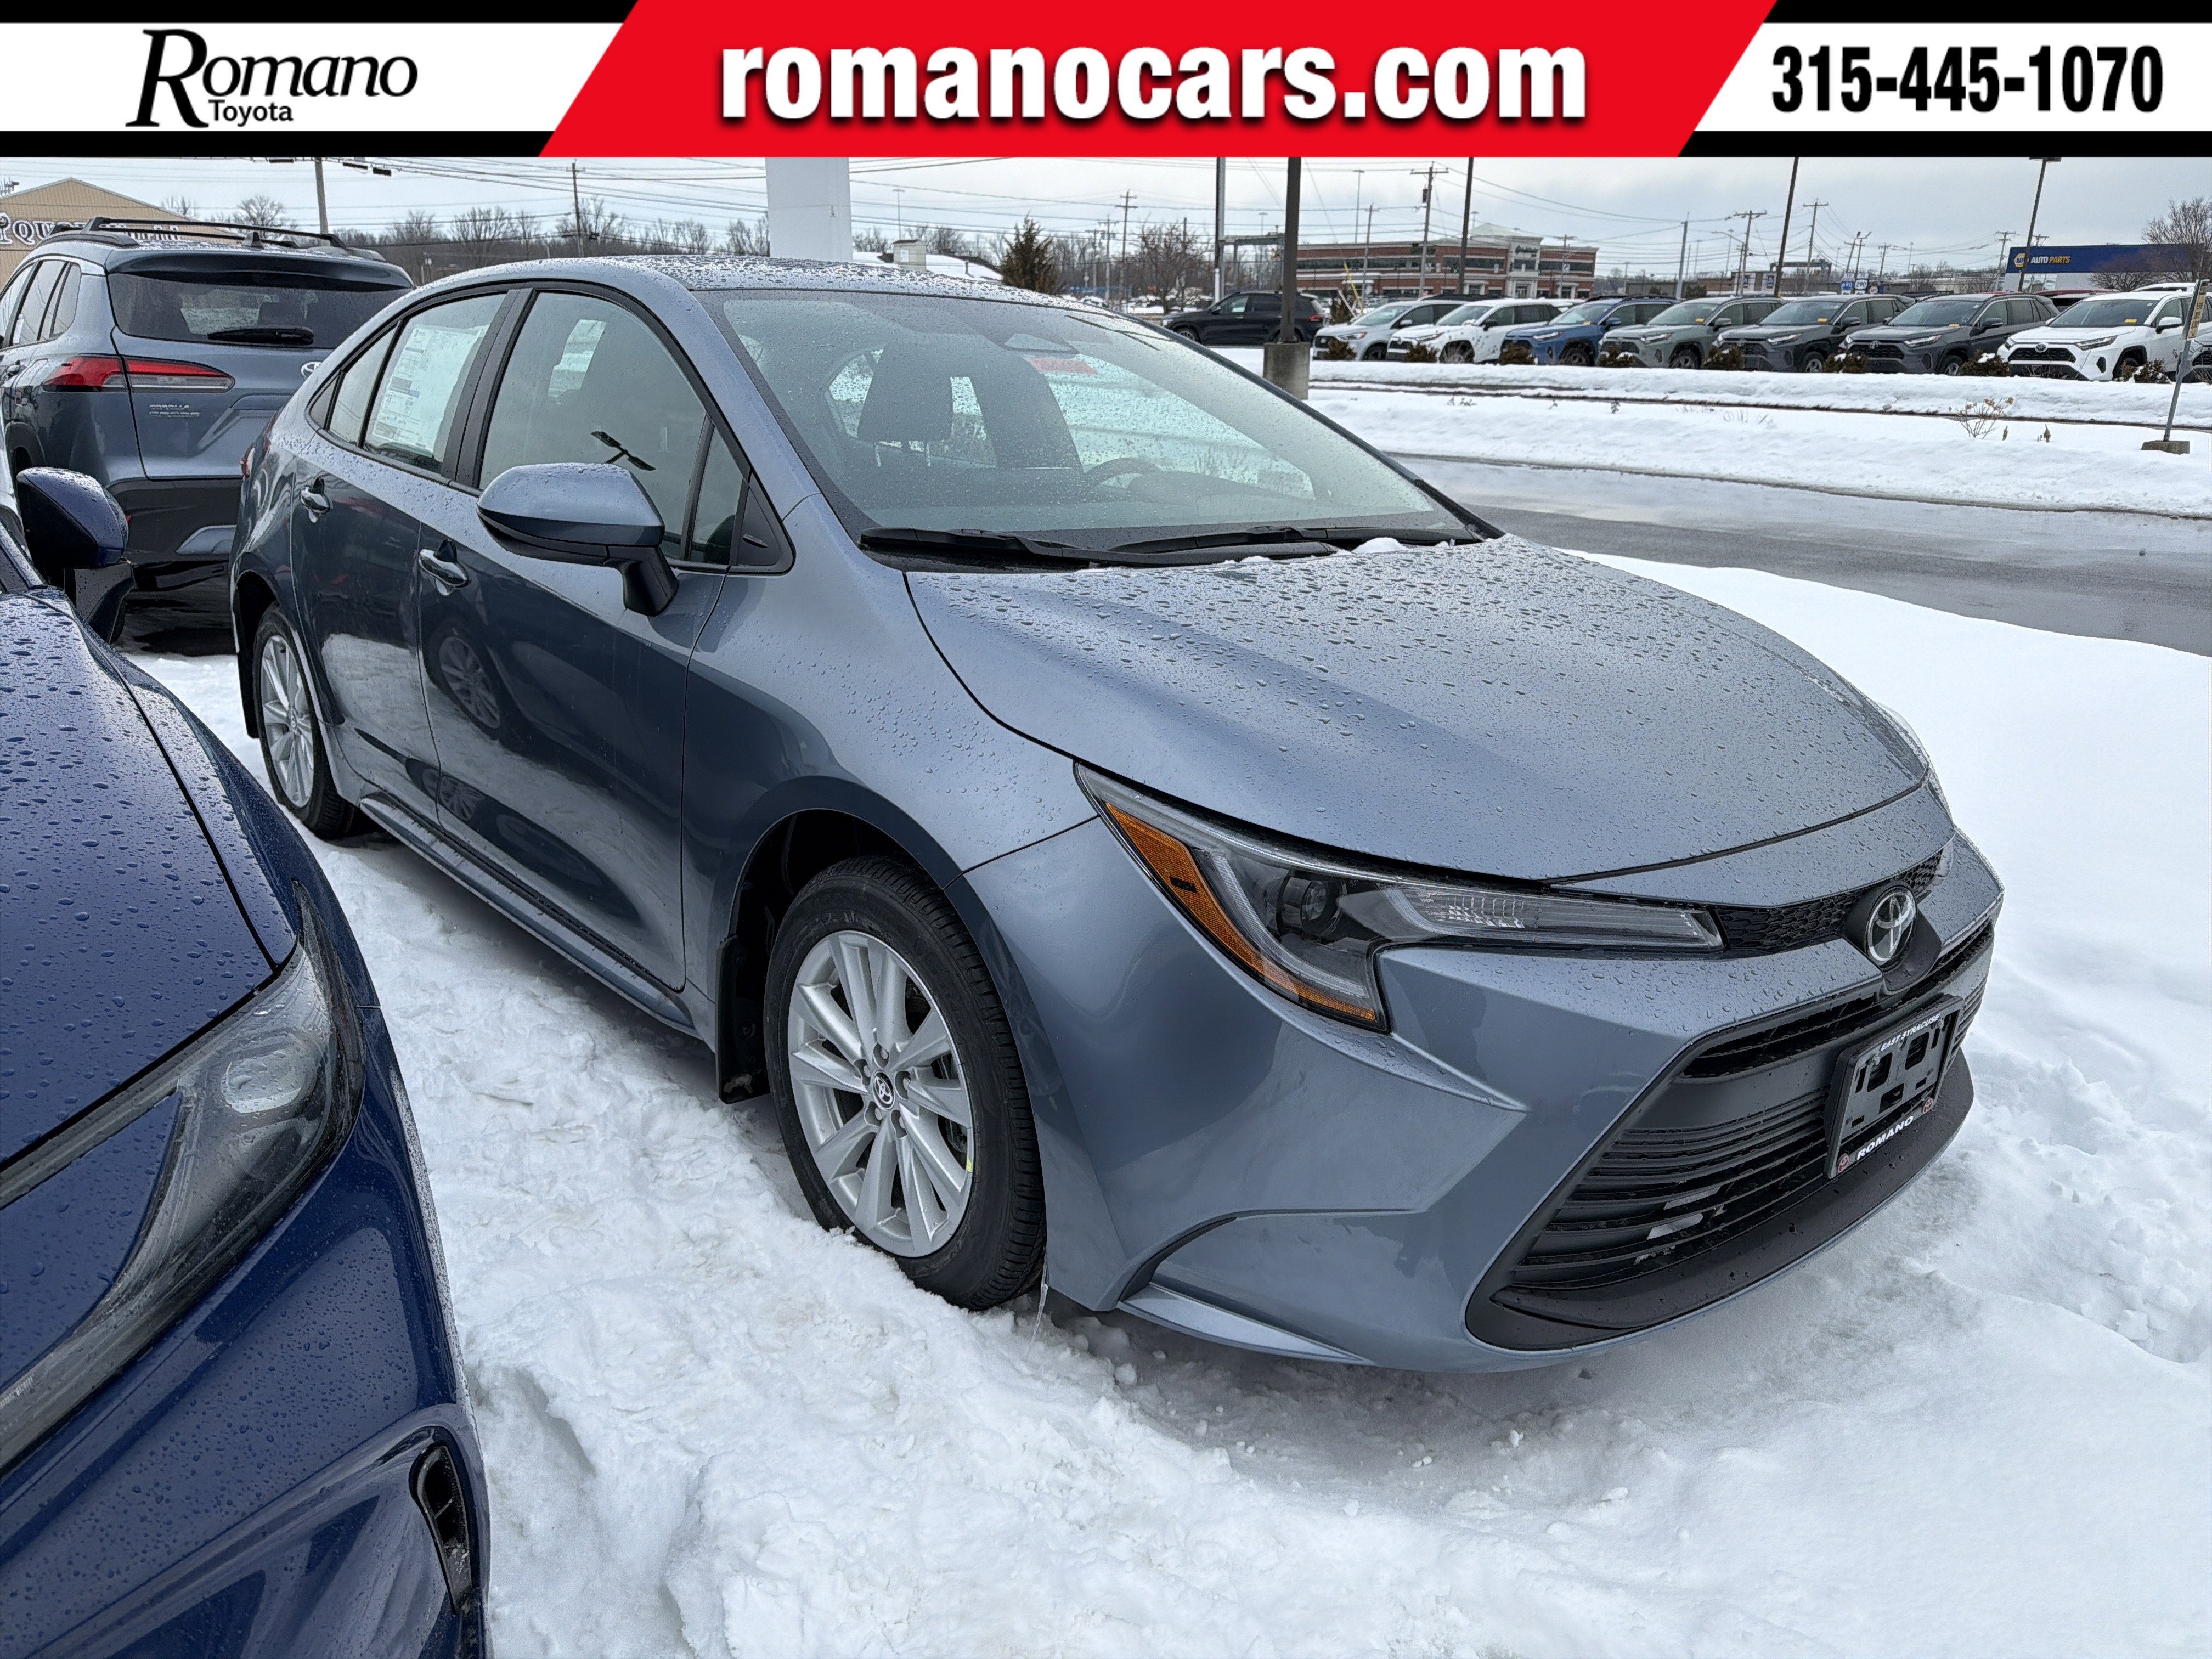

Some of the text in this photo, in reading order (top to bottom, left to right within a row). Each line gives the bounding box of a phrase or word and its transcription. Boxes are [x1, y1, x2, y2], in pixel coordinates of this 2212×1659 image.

[2030, 256, 2049, 264] AUTO
[1880, 1013, 1941, 1052] EAST SYRACUSE
[1857, 1115, 1914, 1161] ROMANO
